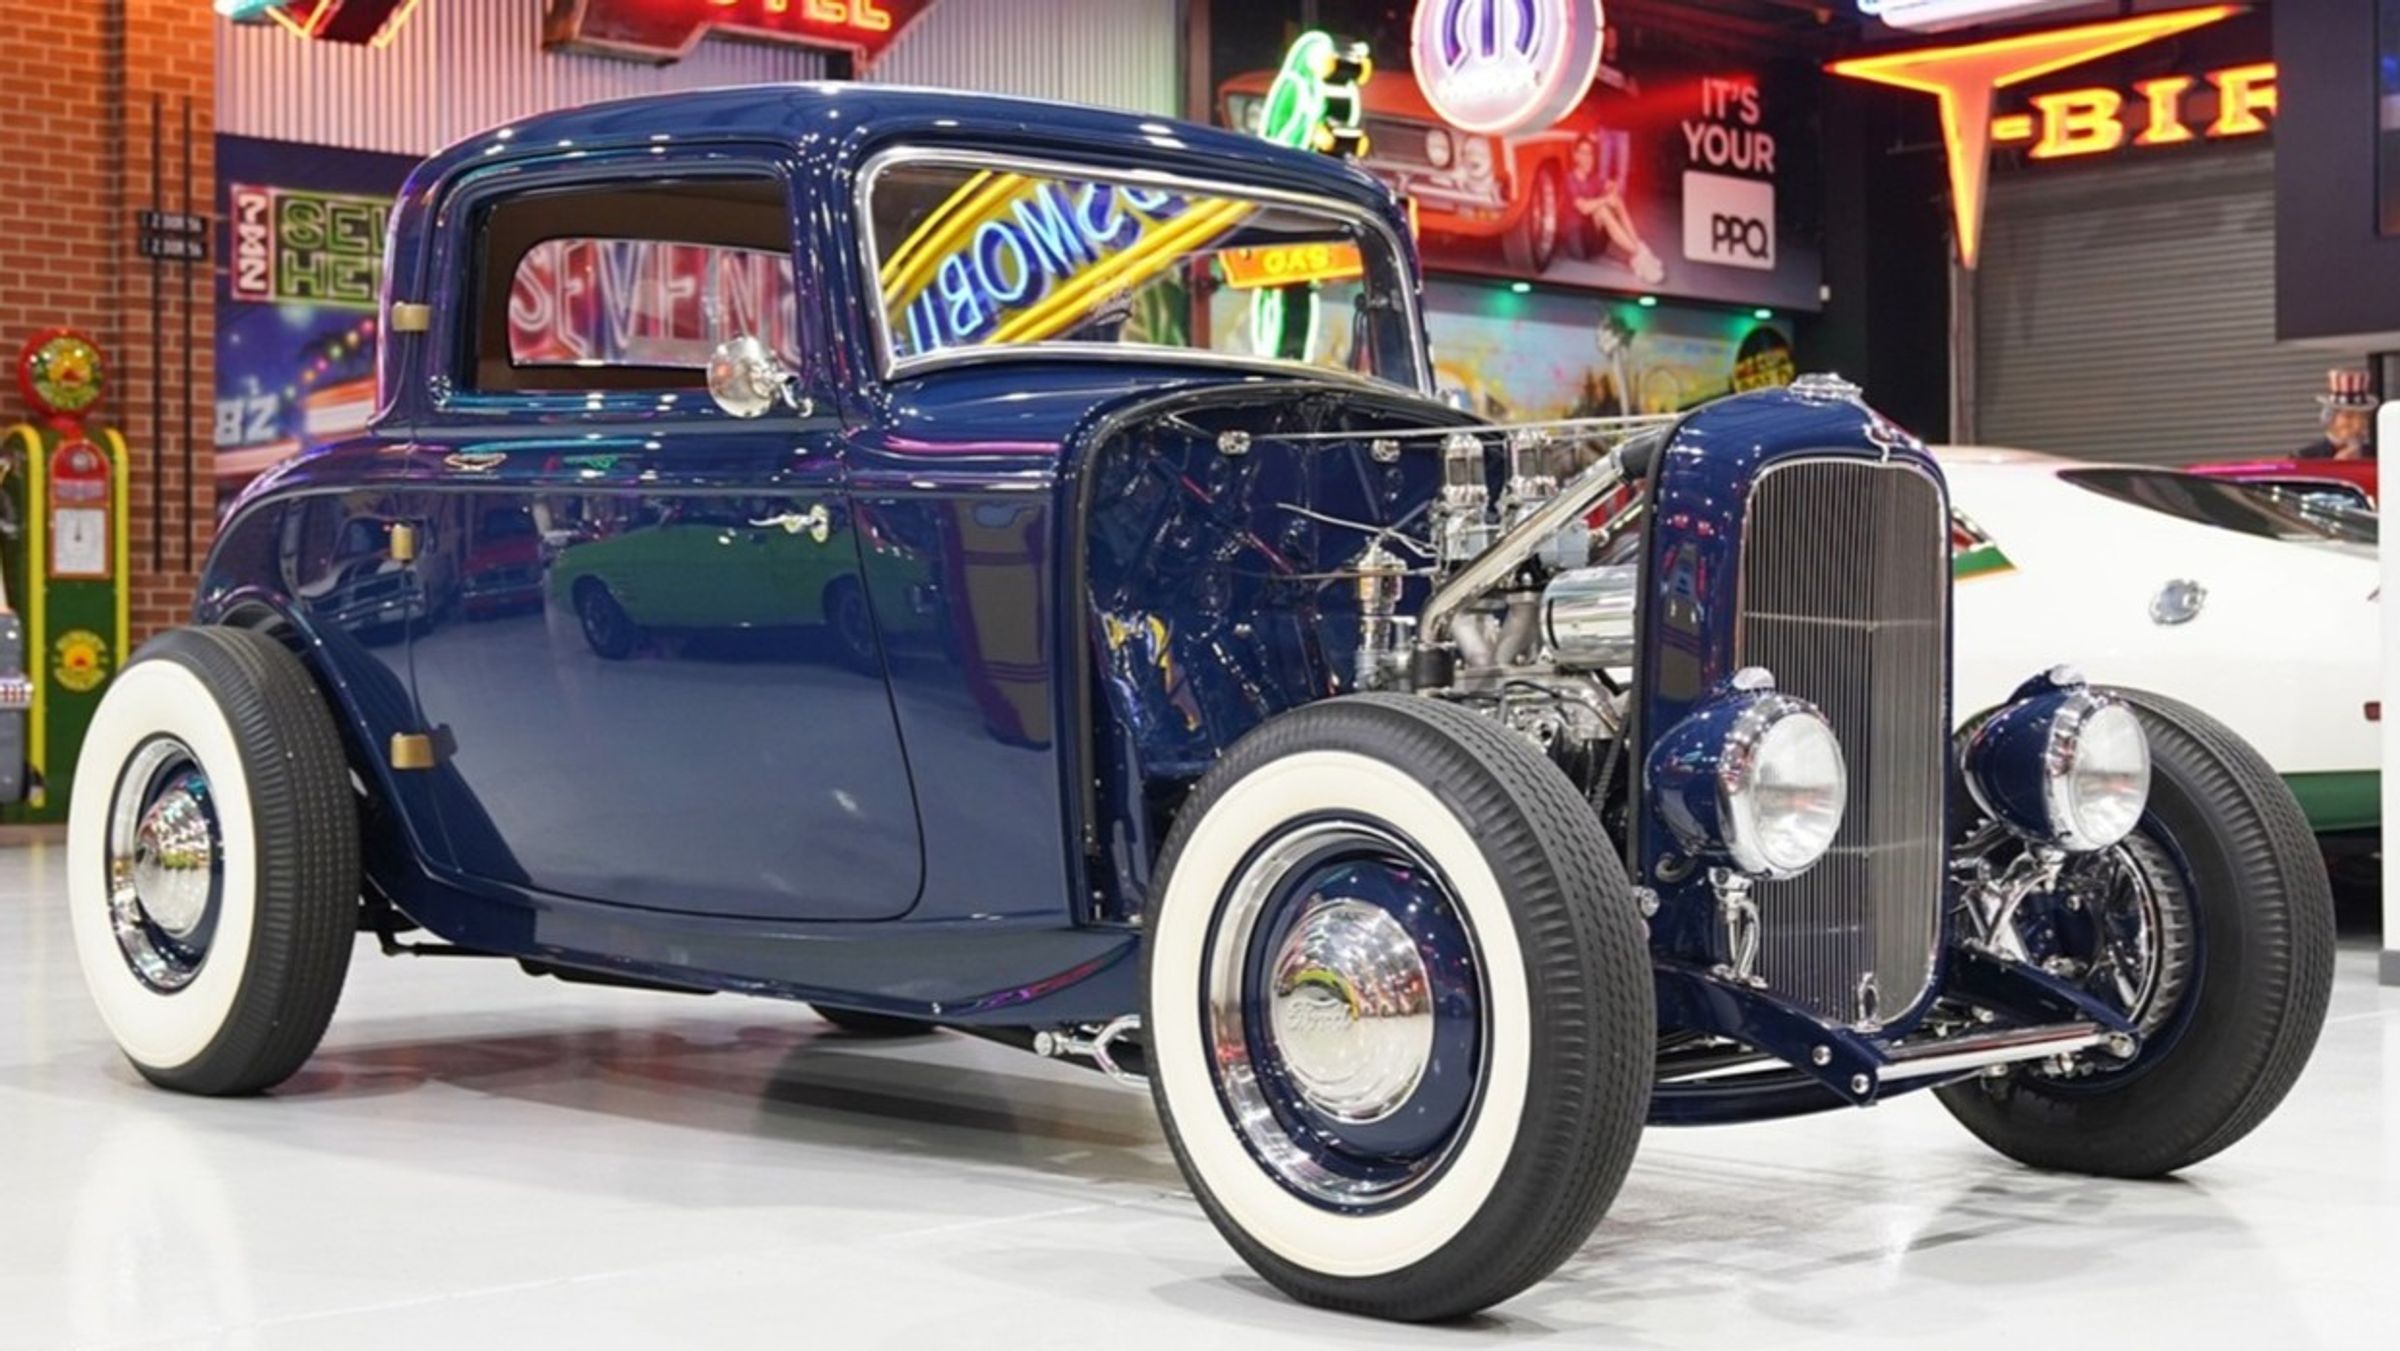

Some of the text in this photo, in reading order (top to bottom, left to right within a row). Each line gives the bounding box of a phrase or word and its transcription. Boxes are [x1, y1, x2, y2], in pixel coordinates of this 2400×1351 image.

[1702, 77, 1760, 126] IT'S
[1682, 120, 1775, 174] YOUR
[1712, 212, 1769, 259] PPQ
